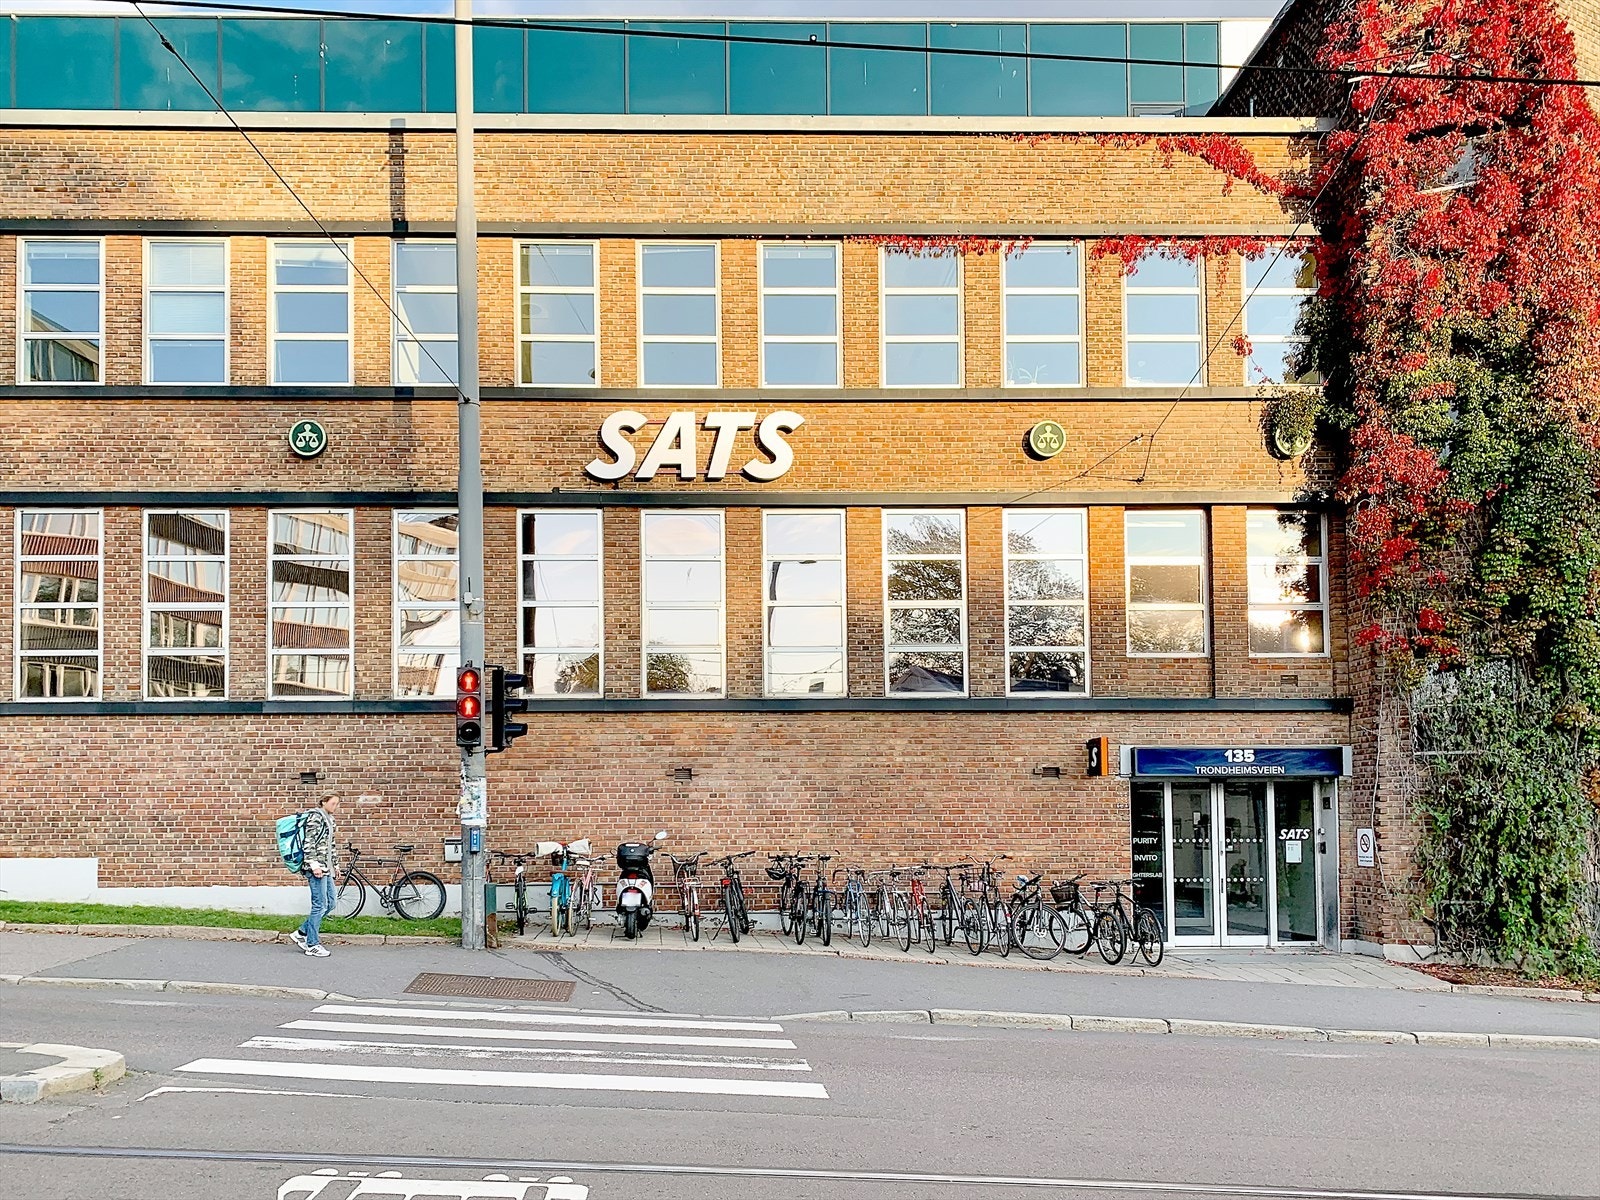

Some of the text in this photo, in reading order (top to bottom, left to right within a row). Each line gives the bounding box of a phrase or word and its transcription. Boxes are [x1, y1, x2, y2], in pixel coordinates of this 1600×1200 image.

[585, 411, 805, 480] SATS
[1091, 747, 1098, 767] S
[1224, 749, 1255, 763] 135
[1195, 766, 1285, 775] TRONDHEIMSVEIEN
[1279, 829, 1310, 839] SATS
